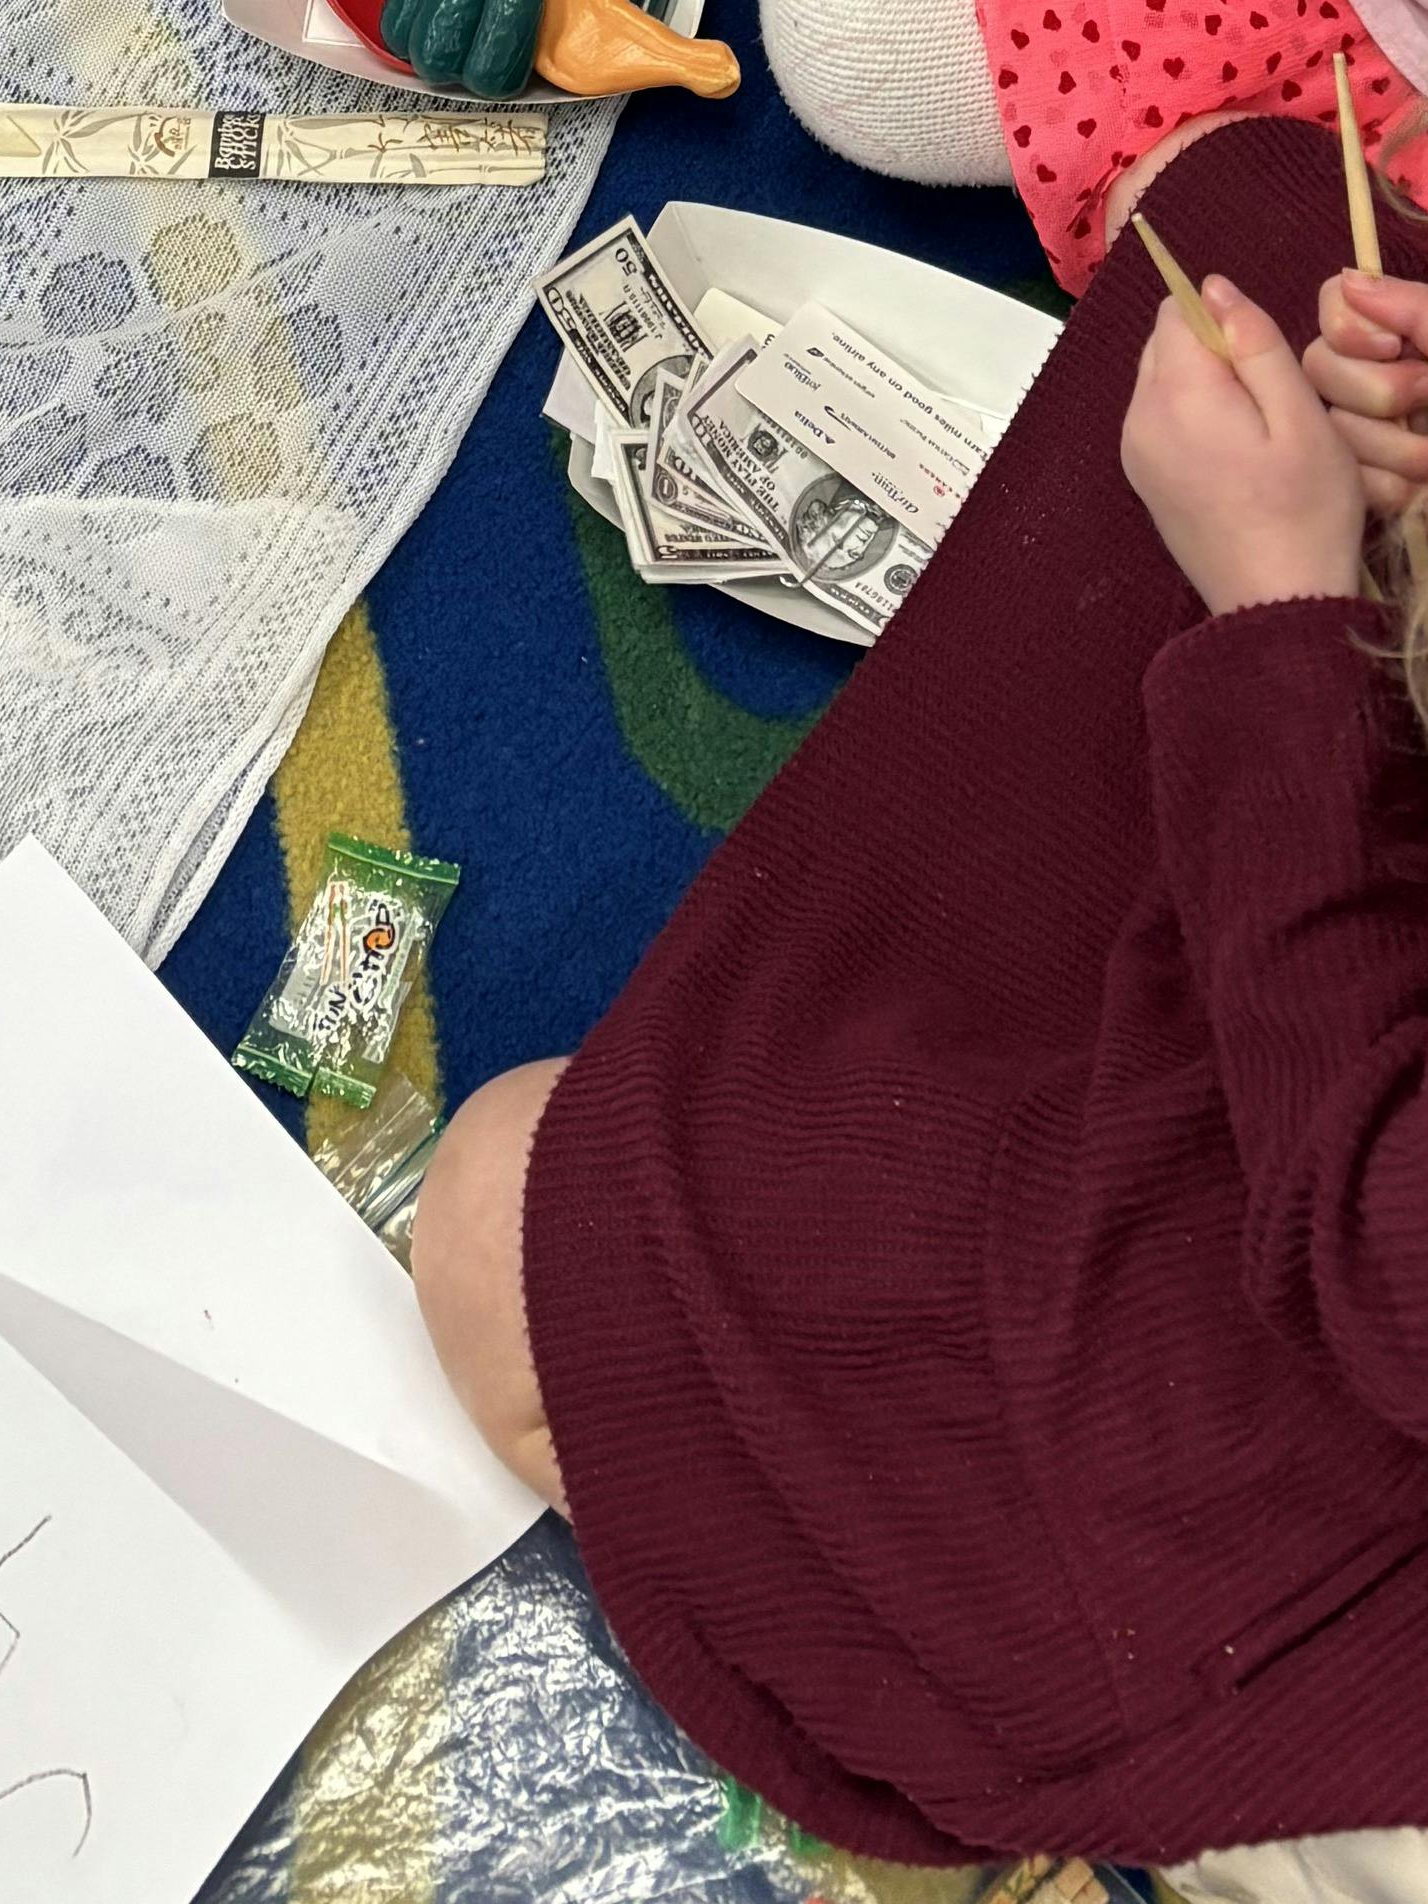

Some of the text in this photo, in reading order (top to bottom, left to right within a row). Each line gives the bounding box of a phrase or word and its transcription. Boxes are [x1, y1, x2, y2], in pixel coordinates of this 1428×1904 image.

[615, 247, 638, 277] 50
[831, 331, 866, 363] airline.
[866, 360, 888, 381] any
[887, 376, 903, 392] on
[903, 389, 934, 415] good
[701, 413, 736, 461] MONEY
[793, 410, 823, 438] Delta
[933, 412, 963, 440] miles
[719, 419, 762, 477] AMERICA
[731, 457, 760, 489] PLAY
[759, 470, 776, 491] OF
[757, 483, 780, 513] THE
[657, 544, 679, 560] 5
